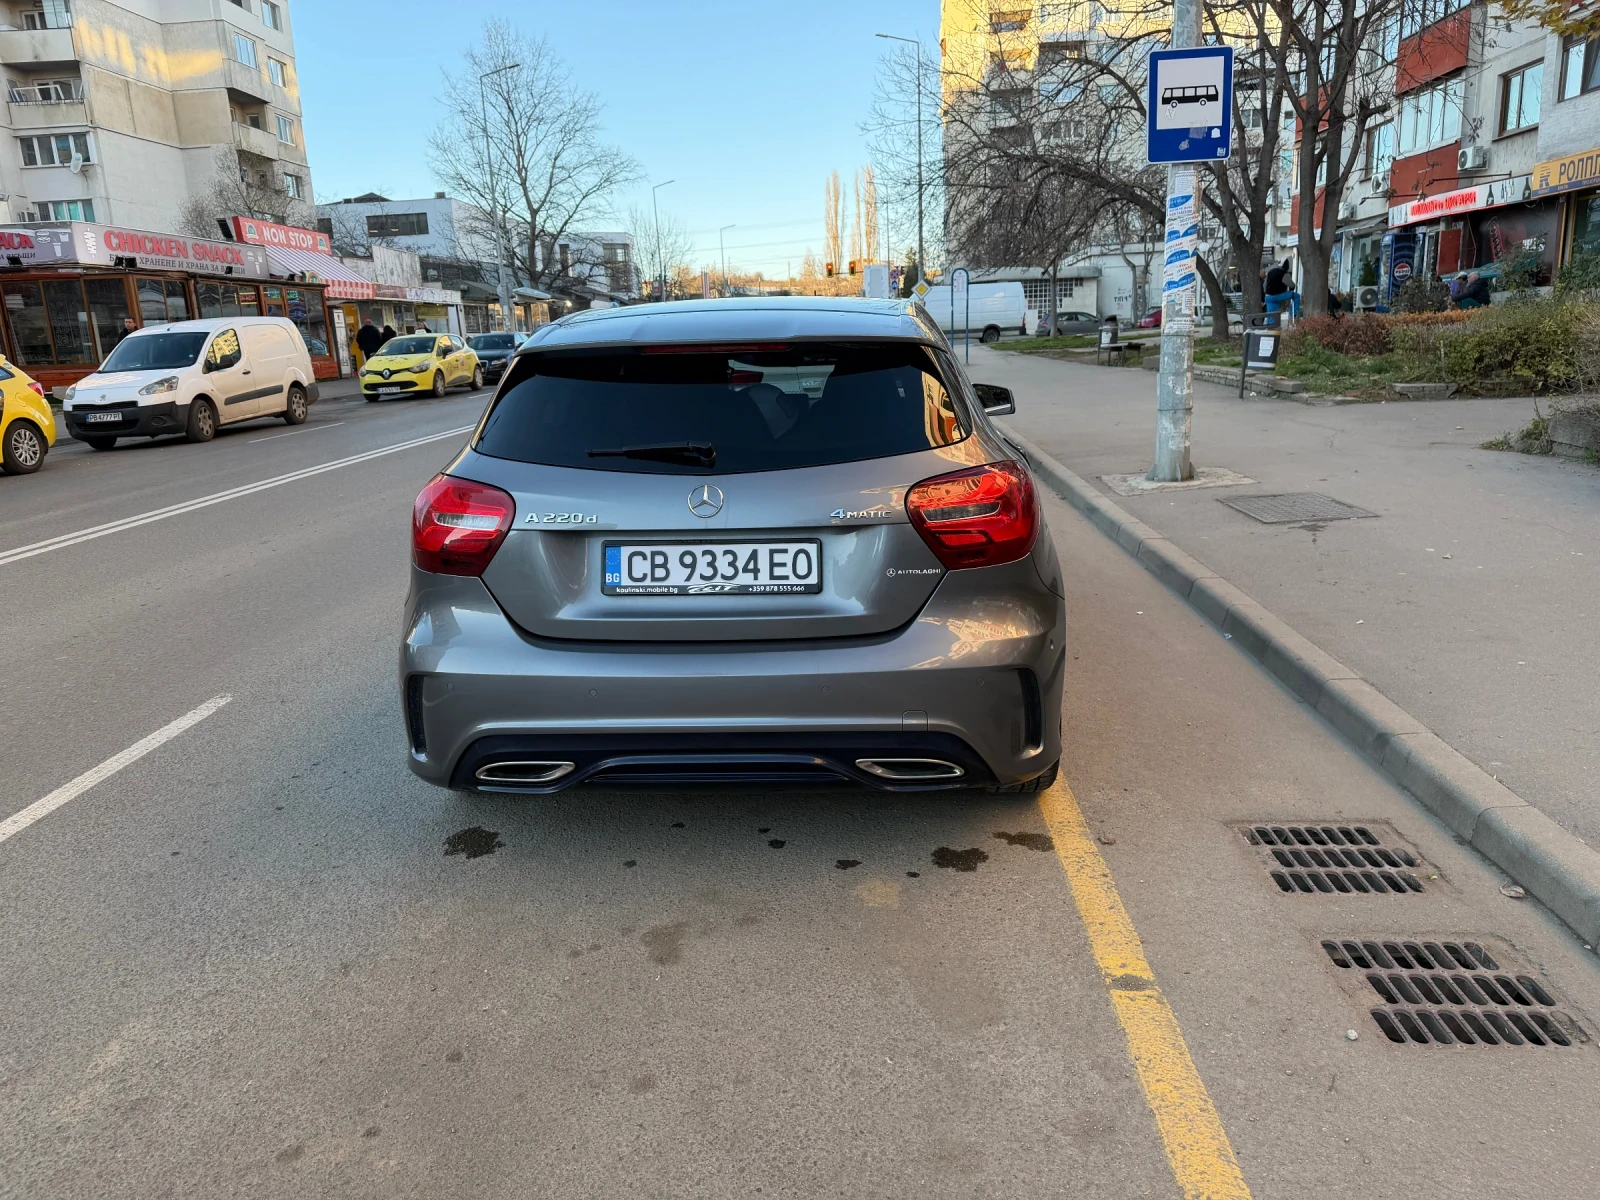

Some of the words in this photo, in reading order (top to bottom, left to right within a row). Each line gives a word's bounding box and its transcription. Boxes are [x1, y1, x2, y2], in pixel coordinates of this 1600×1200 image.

[262, 226, 286, 245] NON
[289, 231, 313, 249] STOP
[103, 230, 189, 259] CHICKEN
[191, 241, 245, 265] SNACK
[139, 256, 176, 268] ХРАНЕНЕ
[182, 263, 210, 272] ХРАНА
[210, 264, 220, 272] ЗА
[220, 265, 246, 275] ВЩИ
[525, 512, 540, 523] A
[830, 508, 892, 519] 4MATIC
[627, 550, 671, 583] CB
[678, 549, 761, 582] 9334
[606, 573, 620, 583] BG
